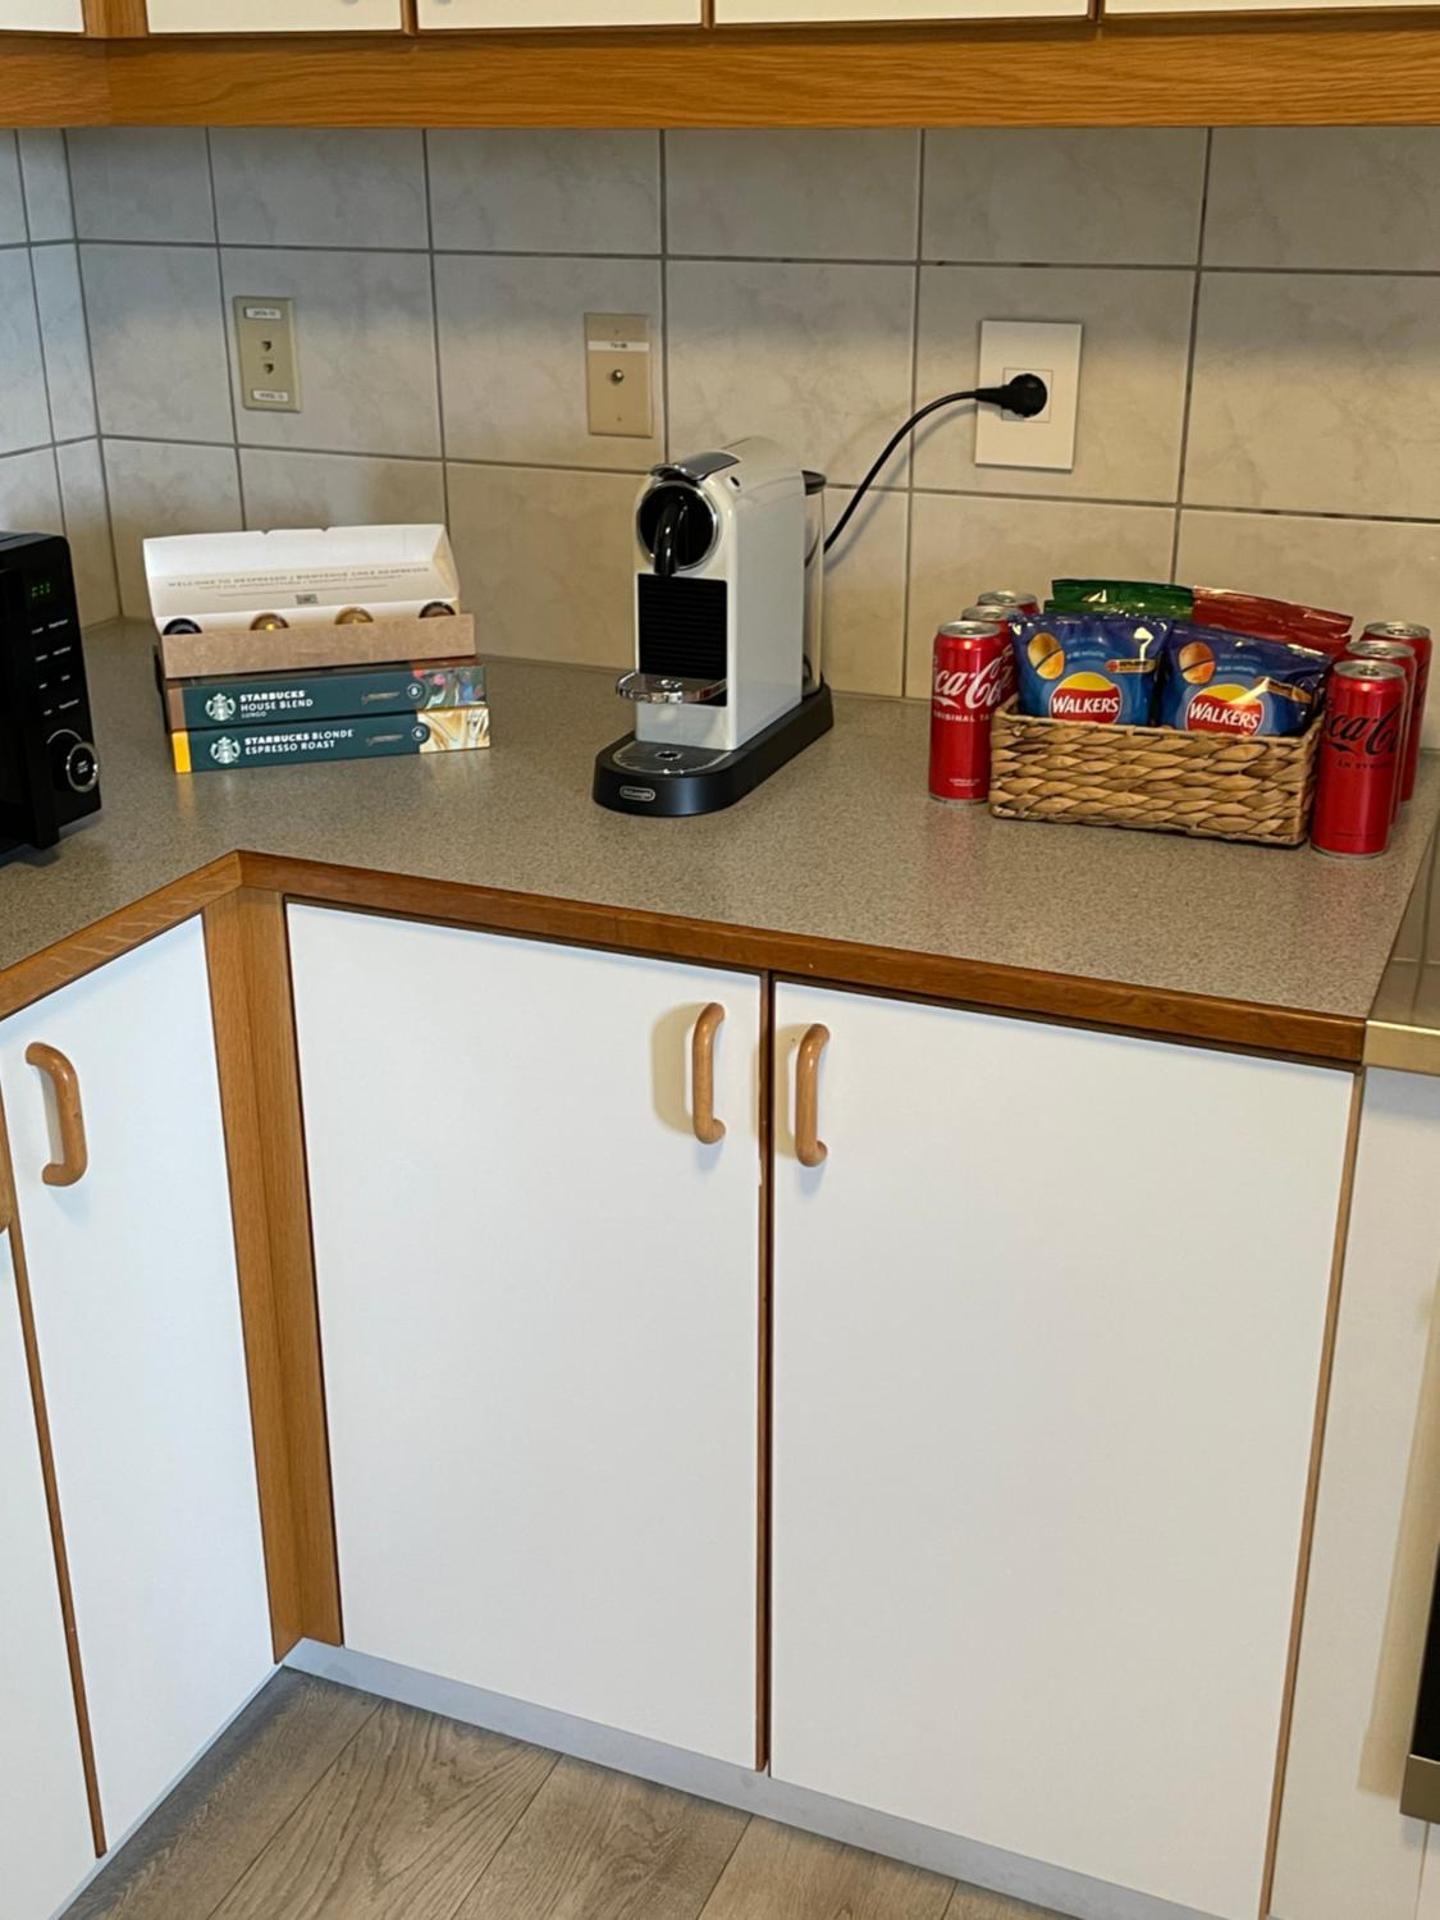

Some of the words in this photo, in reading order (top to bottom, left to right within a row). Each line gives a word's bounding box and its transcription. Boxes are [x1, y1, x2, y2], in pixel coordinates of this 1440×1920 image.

[240, 690, 306, 702] STARBUCKS
[1052, 695, 1119, 713] WALKERS
[241, 701, 276, 712] HOUSE
[279, 698, 314, 709] BLEND
[1189, 702, 1260, 729] WALKERS
[244, 733, 309, 746] STARBUCKS
[311, 729, 353, 741] BLONDE
[245, 743, 298, 755] ESPRESSO
[300, 740, 336, 750] ROAST
